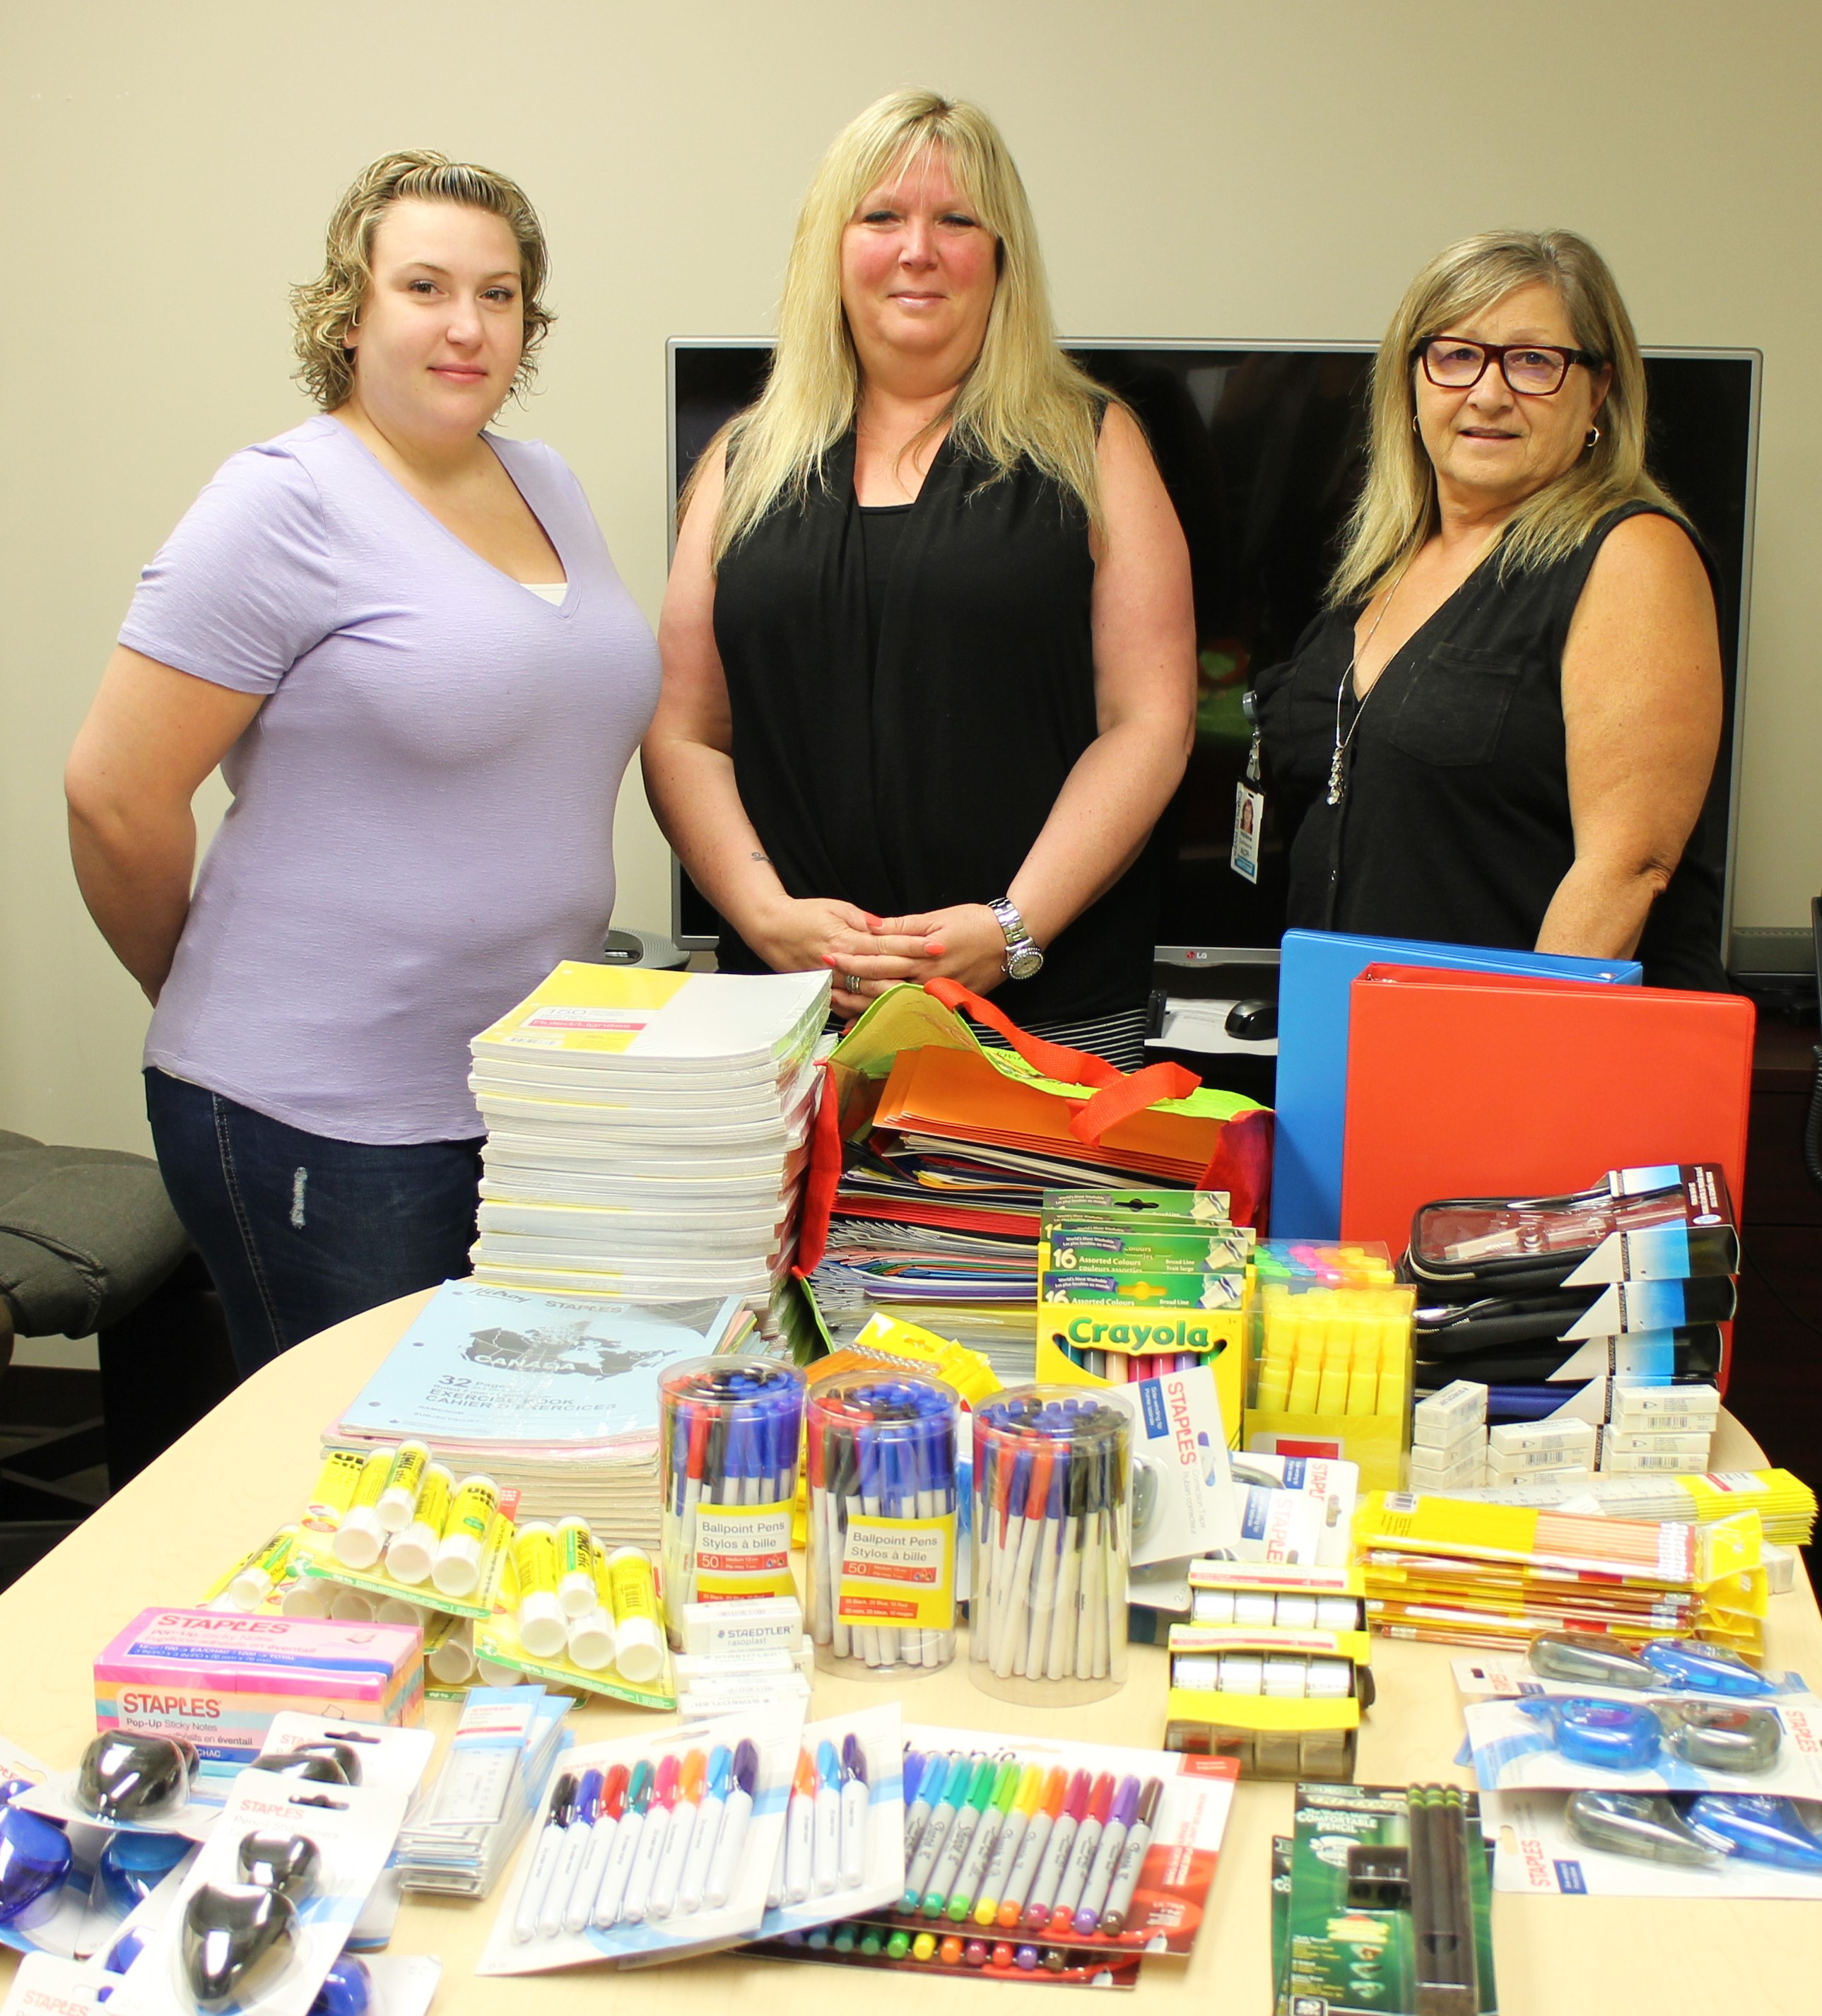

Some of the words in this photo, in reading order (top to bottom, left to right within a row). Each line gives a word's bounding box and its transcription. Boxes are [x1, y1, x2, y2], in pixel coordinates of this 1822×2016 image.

[1052, 1248, 1078, 1270] 16
[1078, 1256, 1112, 1265] Assorted
[1112, 1258, 1142, 1267] Colours
[545, 1300, 623, 1313] STAPLES
[1069, 1317, 1209, 1351] Crayola
[474, 1354, 577, 1371] CANADA
[437, 1374, 472, 1388] 32
[425, 1395, 493, 1409] CAHIER
[1168, 1381, 1197, 1466] STAPLES
[1309, 1463, 1329, 1501] STAPL
[702, 1521, 753, 1535] Ballpoint
[758, 1521, 785, 1532] Pens
[1266, 1496, 1293, 1564] STAPLE
[576, 1530, 593, 1553] UHU
[702, 1537, 739, 1550] Stylos
[742, 1539, 749, 1549] à
[753, 1538, 777, 1549] bille
[852, 1532, 906, 1546] Ballpoint
[910, 1536, 939, 1547] Pens
[851, 1546, 888, 1559] Stylos
[892, 1550, 900, 1560] à
[903, 1551, 928, 1562] bille
[701, 1555, 719, 1569] 50
[847, 1562, 867, 1575] 50
[156, 1614, 291, 1635] STAPLES
[150, 1629, 200, 1640] Pop-Up
[239, 1634, 275, 1643] Notes
[727, 1626, 791, 1639] STAEDTLER
[252, 1641, 265, 1651] en
[727, 1637, 768, 1648] rasoplast
[123, 1692, 221, 1718] STAPLES
[126, 1718, 163, 1730] Pop-Up
[165, 1720, 191, 1732] Sticky
[192, 1722, 218, 1733] Notes
[1785, 1710, 1819, 1753] STAPLES
[204, 1735, 216, 1743] en
[216, 1734, 253, 1746] éventail
[197, 1748, 221, 1758] CHAC
[239, 1799, 305, 1820] STAPLES
[1296, 1810, 1378, 1829] COMFORTABLE
[1316, 1822, 1358, 1833] PENCIL
[1520, 1840, 1551, 1887] STAPLES
[22, 1988, 90, 2016] STAPLES
